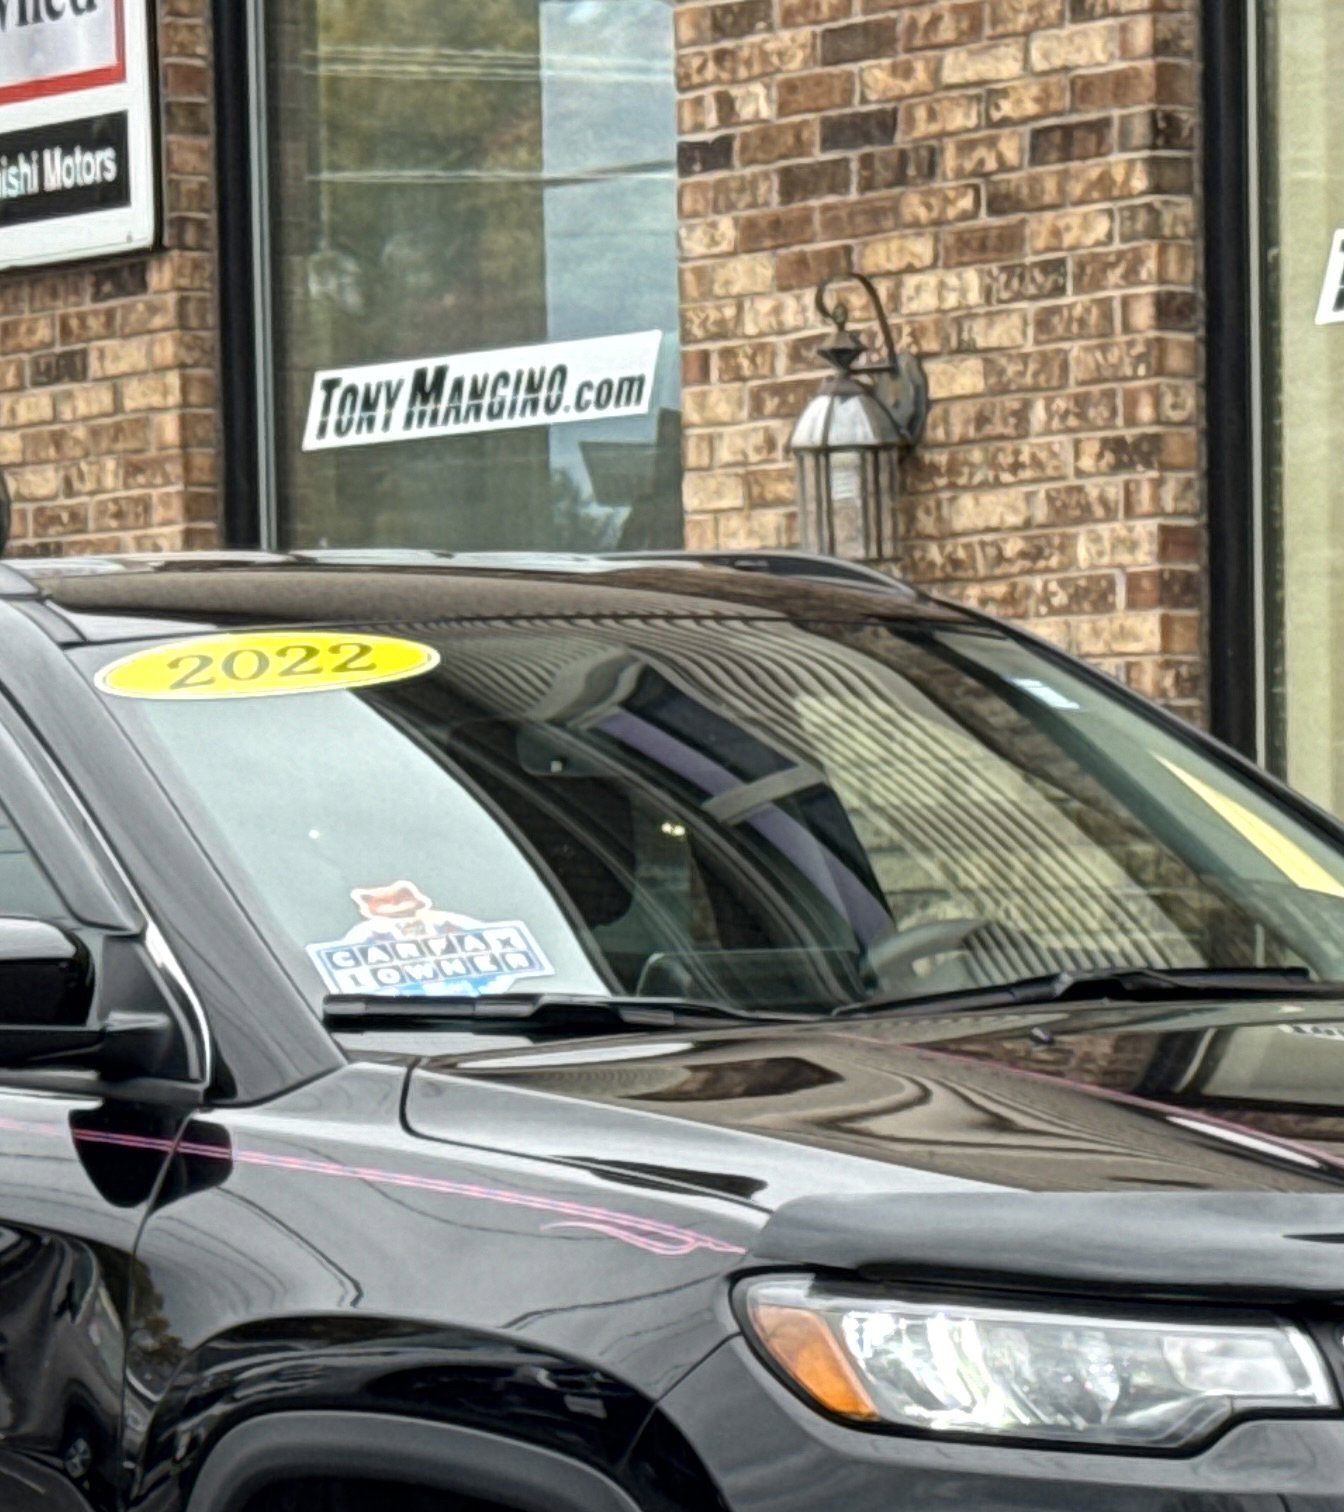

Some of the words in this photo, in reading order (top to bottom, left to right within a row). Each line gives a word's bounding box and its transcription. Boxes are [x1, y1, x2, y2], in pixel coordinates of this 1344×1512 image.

[42, 145, 117, 192] Motors
[315, 376, 405, 440] TONY
[166, 641, 377, 690] 2022
[329, 930, 519, 969] CARFAX
[374, 952, 532, 986] OWNER
